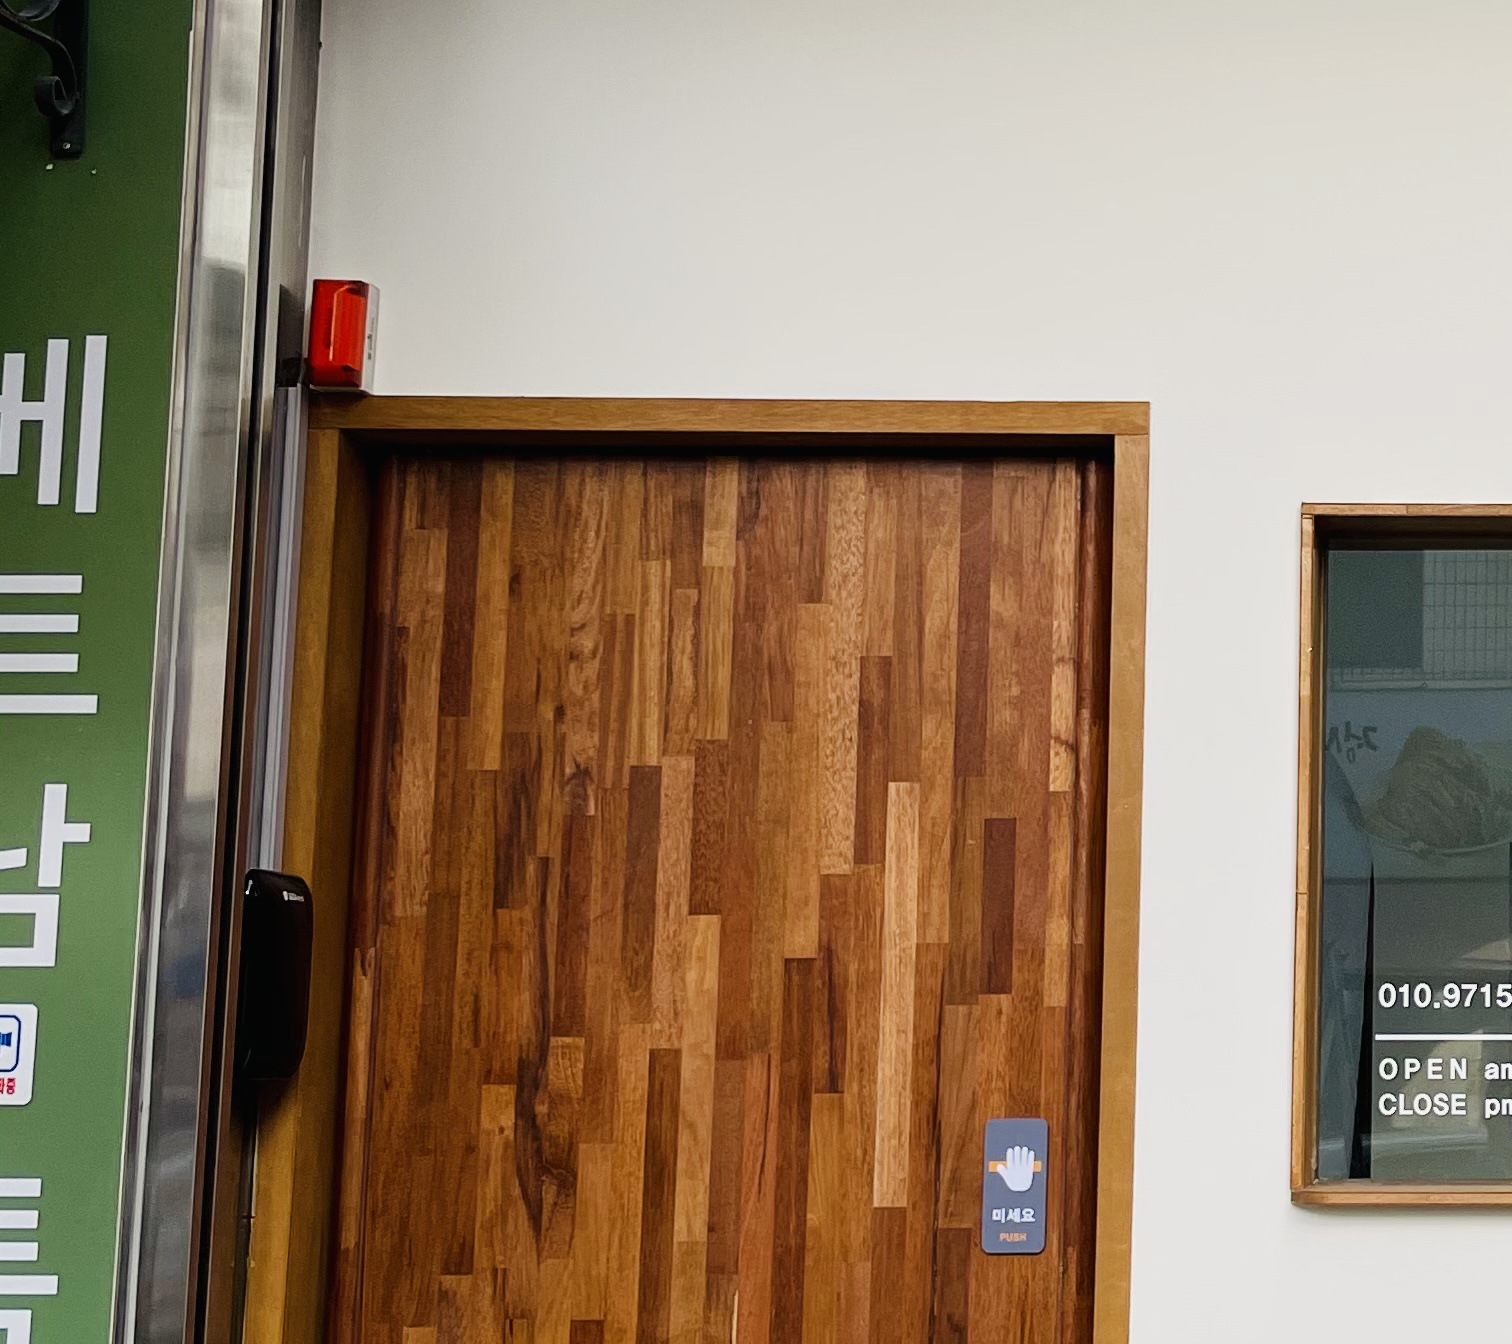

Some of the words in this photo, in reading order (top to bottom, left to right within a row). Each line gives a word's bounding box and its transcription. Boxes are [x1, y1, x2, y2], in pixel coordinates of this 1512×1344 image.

[1378, 1057, 1467, 1080] OPEN
[1378, 1093, 1467, 1116] CLOSE
[991, 1207, 1036, 1224] 미세요
[1000, 1232, 1027, 1243] PUSH
